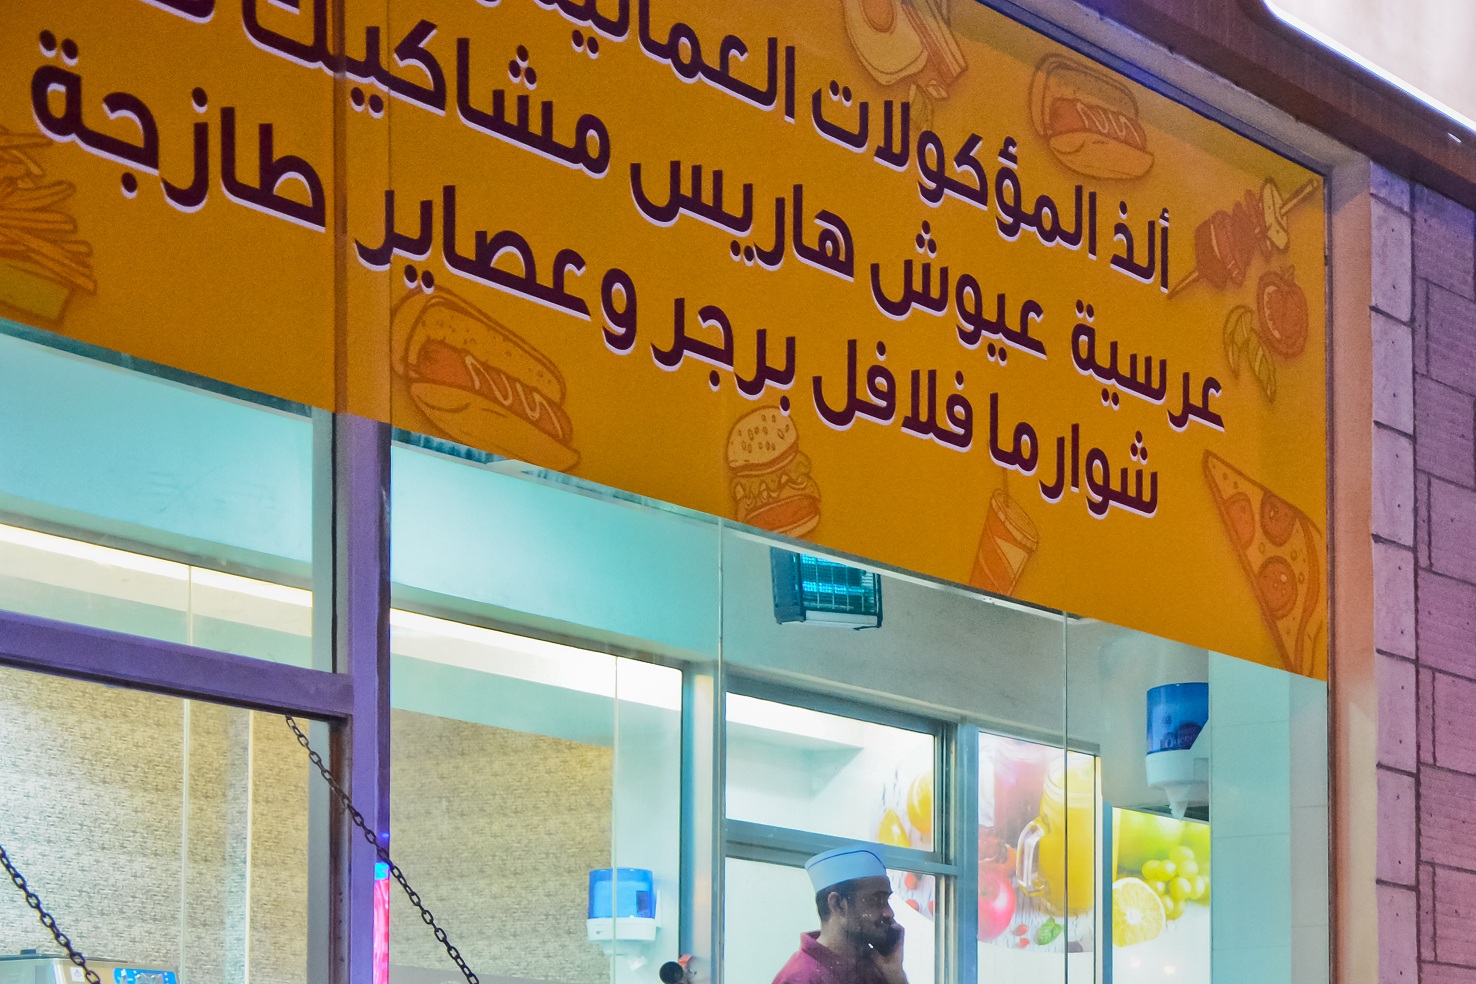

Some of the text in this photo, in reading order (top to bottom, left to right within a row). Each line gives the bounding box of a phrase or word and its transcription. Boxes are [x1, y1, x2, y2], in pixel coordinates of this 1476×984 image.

[30, 29, 326, 233] طازجة
[811, 79, 1098, 260] المؤكولات
[630, 160, 854, 284] هاريس
[1110, 200, 1170, 294] ألذ
[870, 220, 1048, 366] عيوش
[651, 298, 797, 418] برجر
[811, 339, 974, 453] فلافل
[1070, 299, 1227, 432] عرسية
[987, 392, 1158, 520] شوارما
